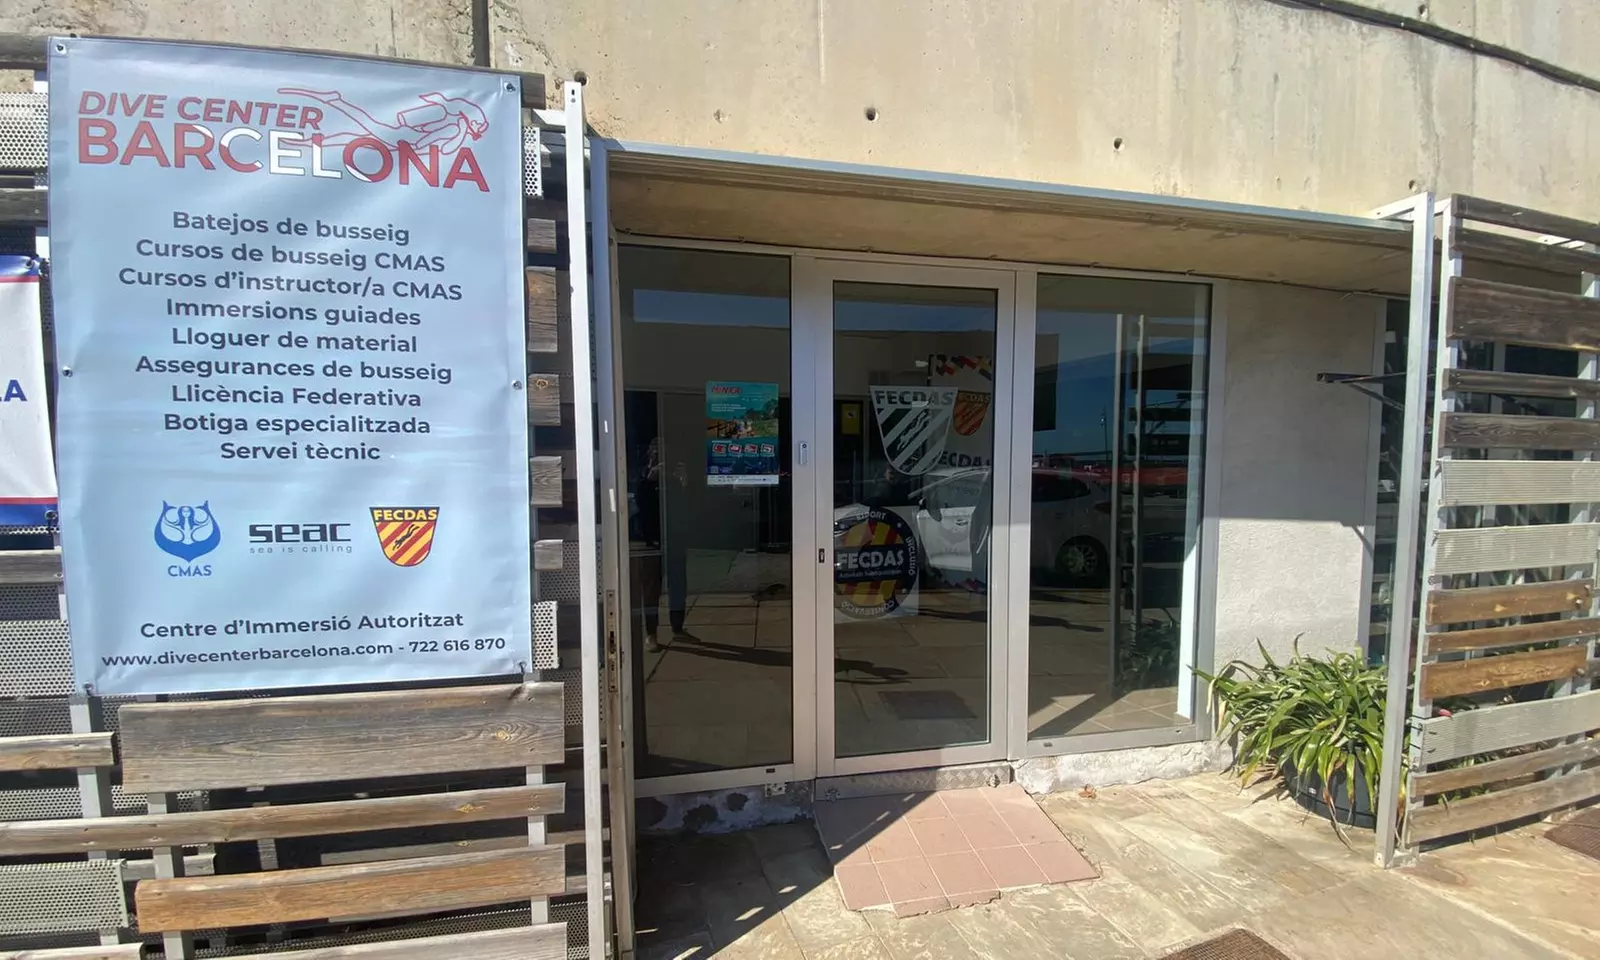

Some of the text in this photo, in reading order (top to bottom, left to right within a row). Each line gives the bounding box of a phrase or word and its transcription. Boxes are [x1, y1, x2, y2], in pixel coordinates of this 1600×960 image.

[78, 91, 323, 130] DIVE CENTER
[78, 118, 490, 192] BARCELONA
[174, 212, 409, 246] Batejos de busseig
[136, 239, 445, 272] Cursos de busseig CMAS
[119, 268, 462, 300] Cursos d’instructor/a CMAS
[167, 299, 421, 325] Immersions guiades
[173, 327, 416, 352] Lloguer de material
[136, 356, 451, 384] Assegurances de busseig
[0, 379, 27, 402] A
[172, 384, 421, 406] Llicència Federativa
[874, 390, 953, 405] FECDAS
[164, 413, 430, 436] Botiga especialitzada
[221, 441, 380, 460] Servei tècnic
[373, 509, 438, 521] FECDAS
[249, 523, 351, 543] seac
[302, 544, 352, 554] calling
[835, 549, 905, 570] FECDAS
[168, 565, 212, 577] CMAS
[141, 612, 464, 638] Centre d’Immersió Autoritzat
[101, 645, 393, 666] www.divecenterbarcelona.com
[409, 641, 439, 653] 722
[443, 640, 470, 651] 616
[475, 638, 505, 650] 870
